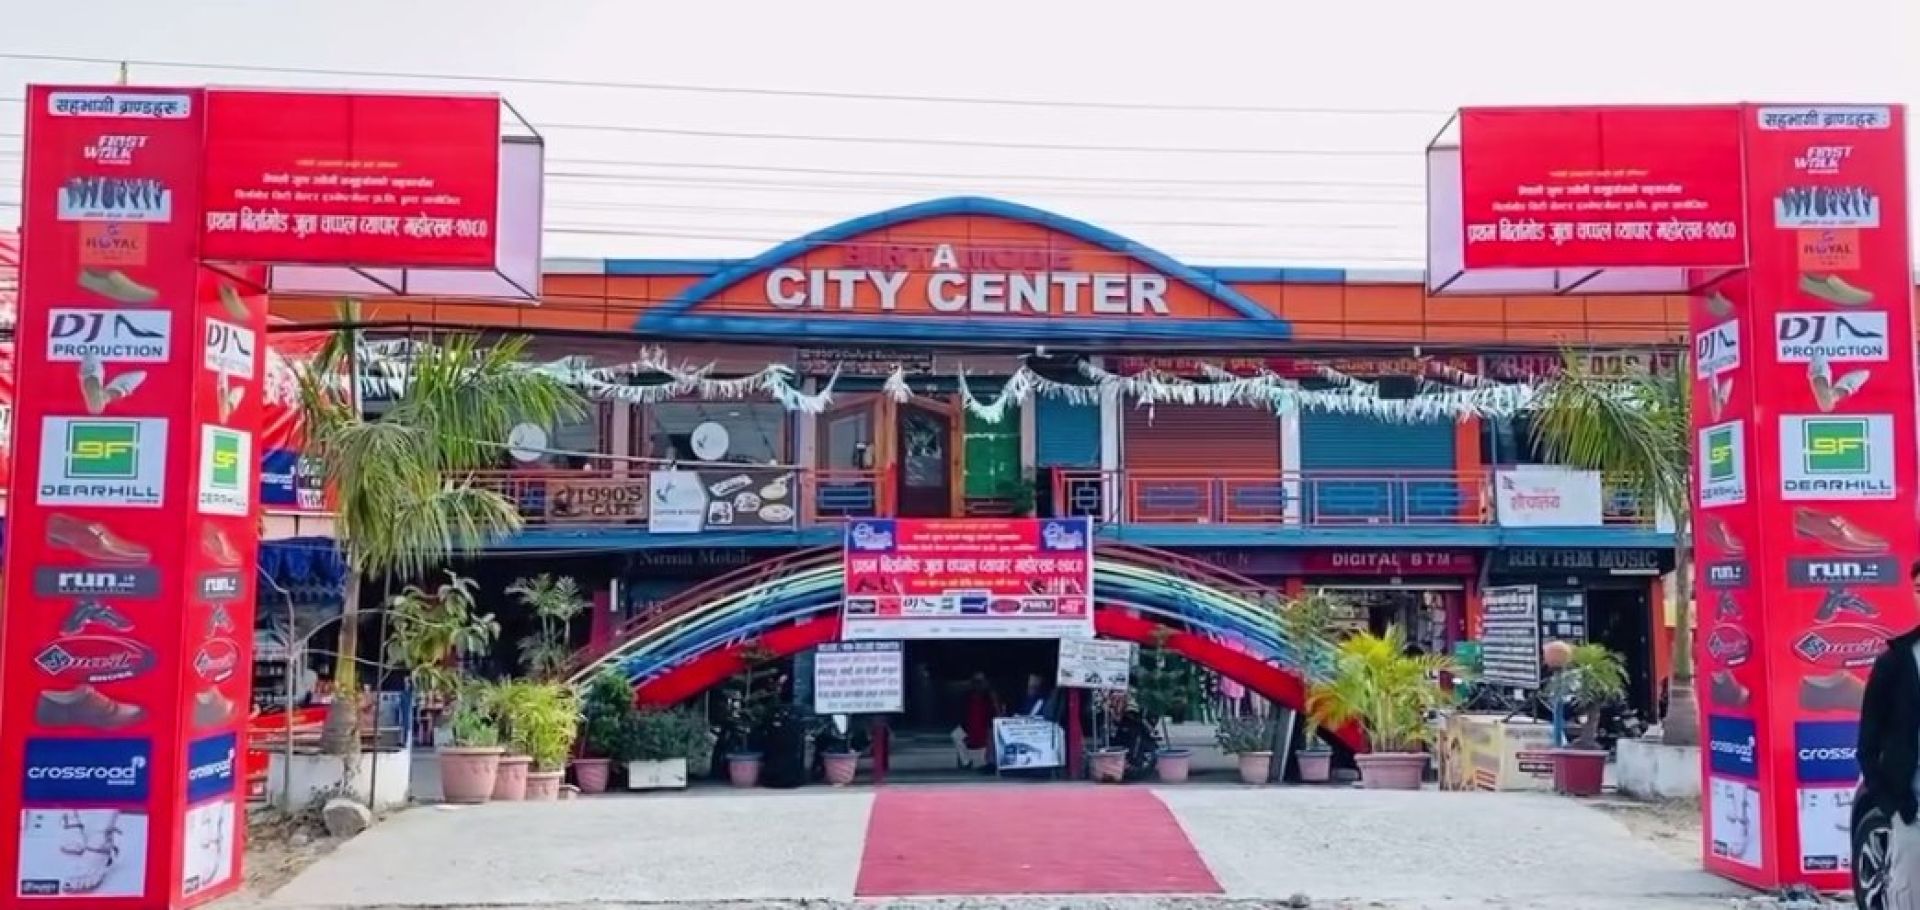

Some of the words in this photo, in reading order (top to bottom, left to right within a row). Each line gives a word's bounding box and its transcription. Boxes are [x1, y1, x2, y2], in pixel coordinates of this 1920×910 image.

[99, 136, 148, 147] FIRST
[84, 146, 132, 159] WALK
[1807, 146, 1853, 158] FIRST
[1795, 157, 1839, 169] WALK
[86, 238, 139, 249] ROYAL
[1804, 243, 1850, 253] ROYAL
[766, 268, 910, 311] CITY
[927, 272, 1170, 315] CENTER
[51, 314, 104, 343] DJ
[1779, 316, 1826, 344] DJ
[207, 323, 229, 354] DJ
[53, 344, 163, 356] PRODUCTION
[1699, 330, 1717, 360] DJ
[1783, 345, 1883, 356] PRODUCTION
[1783, 479, 1892, 490] DEARHILL
[41, 485, 160, 497] DEARHILL
[1332, 553, 1399, 567] DIGITAL
[1509, 549, 1593, 568] RHYTHM
[1599, 549, 1659, 568] MUSIC
[28, 756, 146, 779] crossroad
